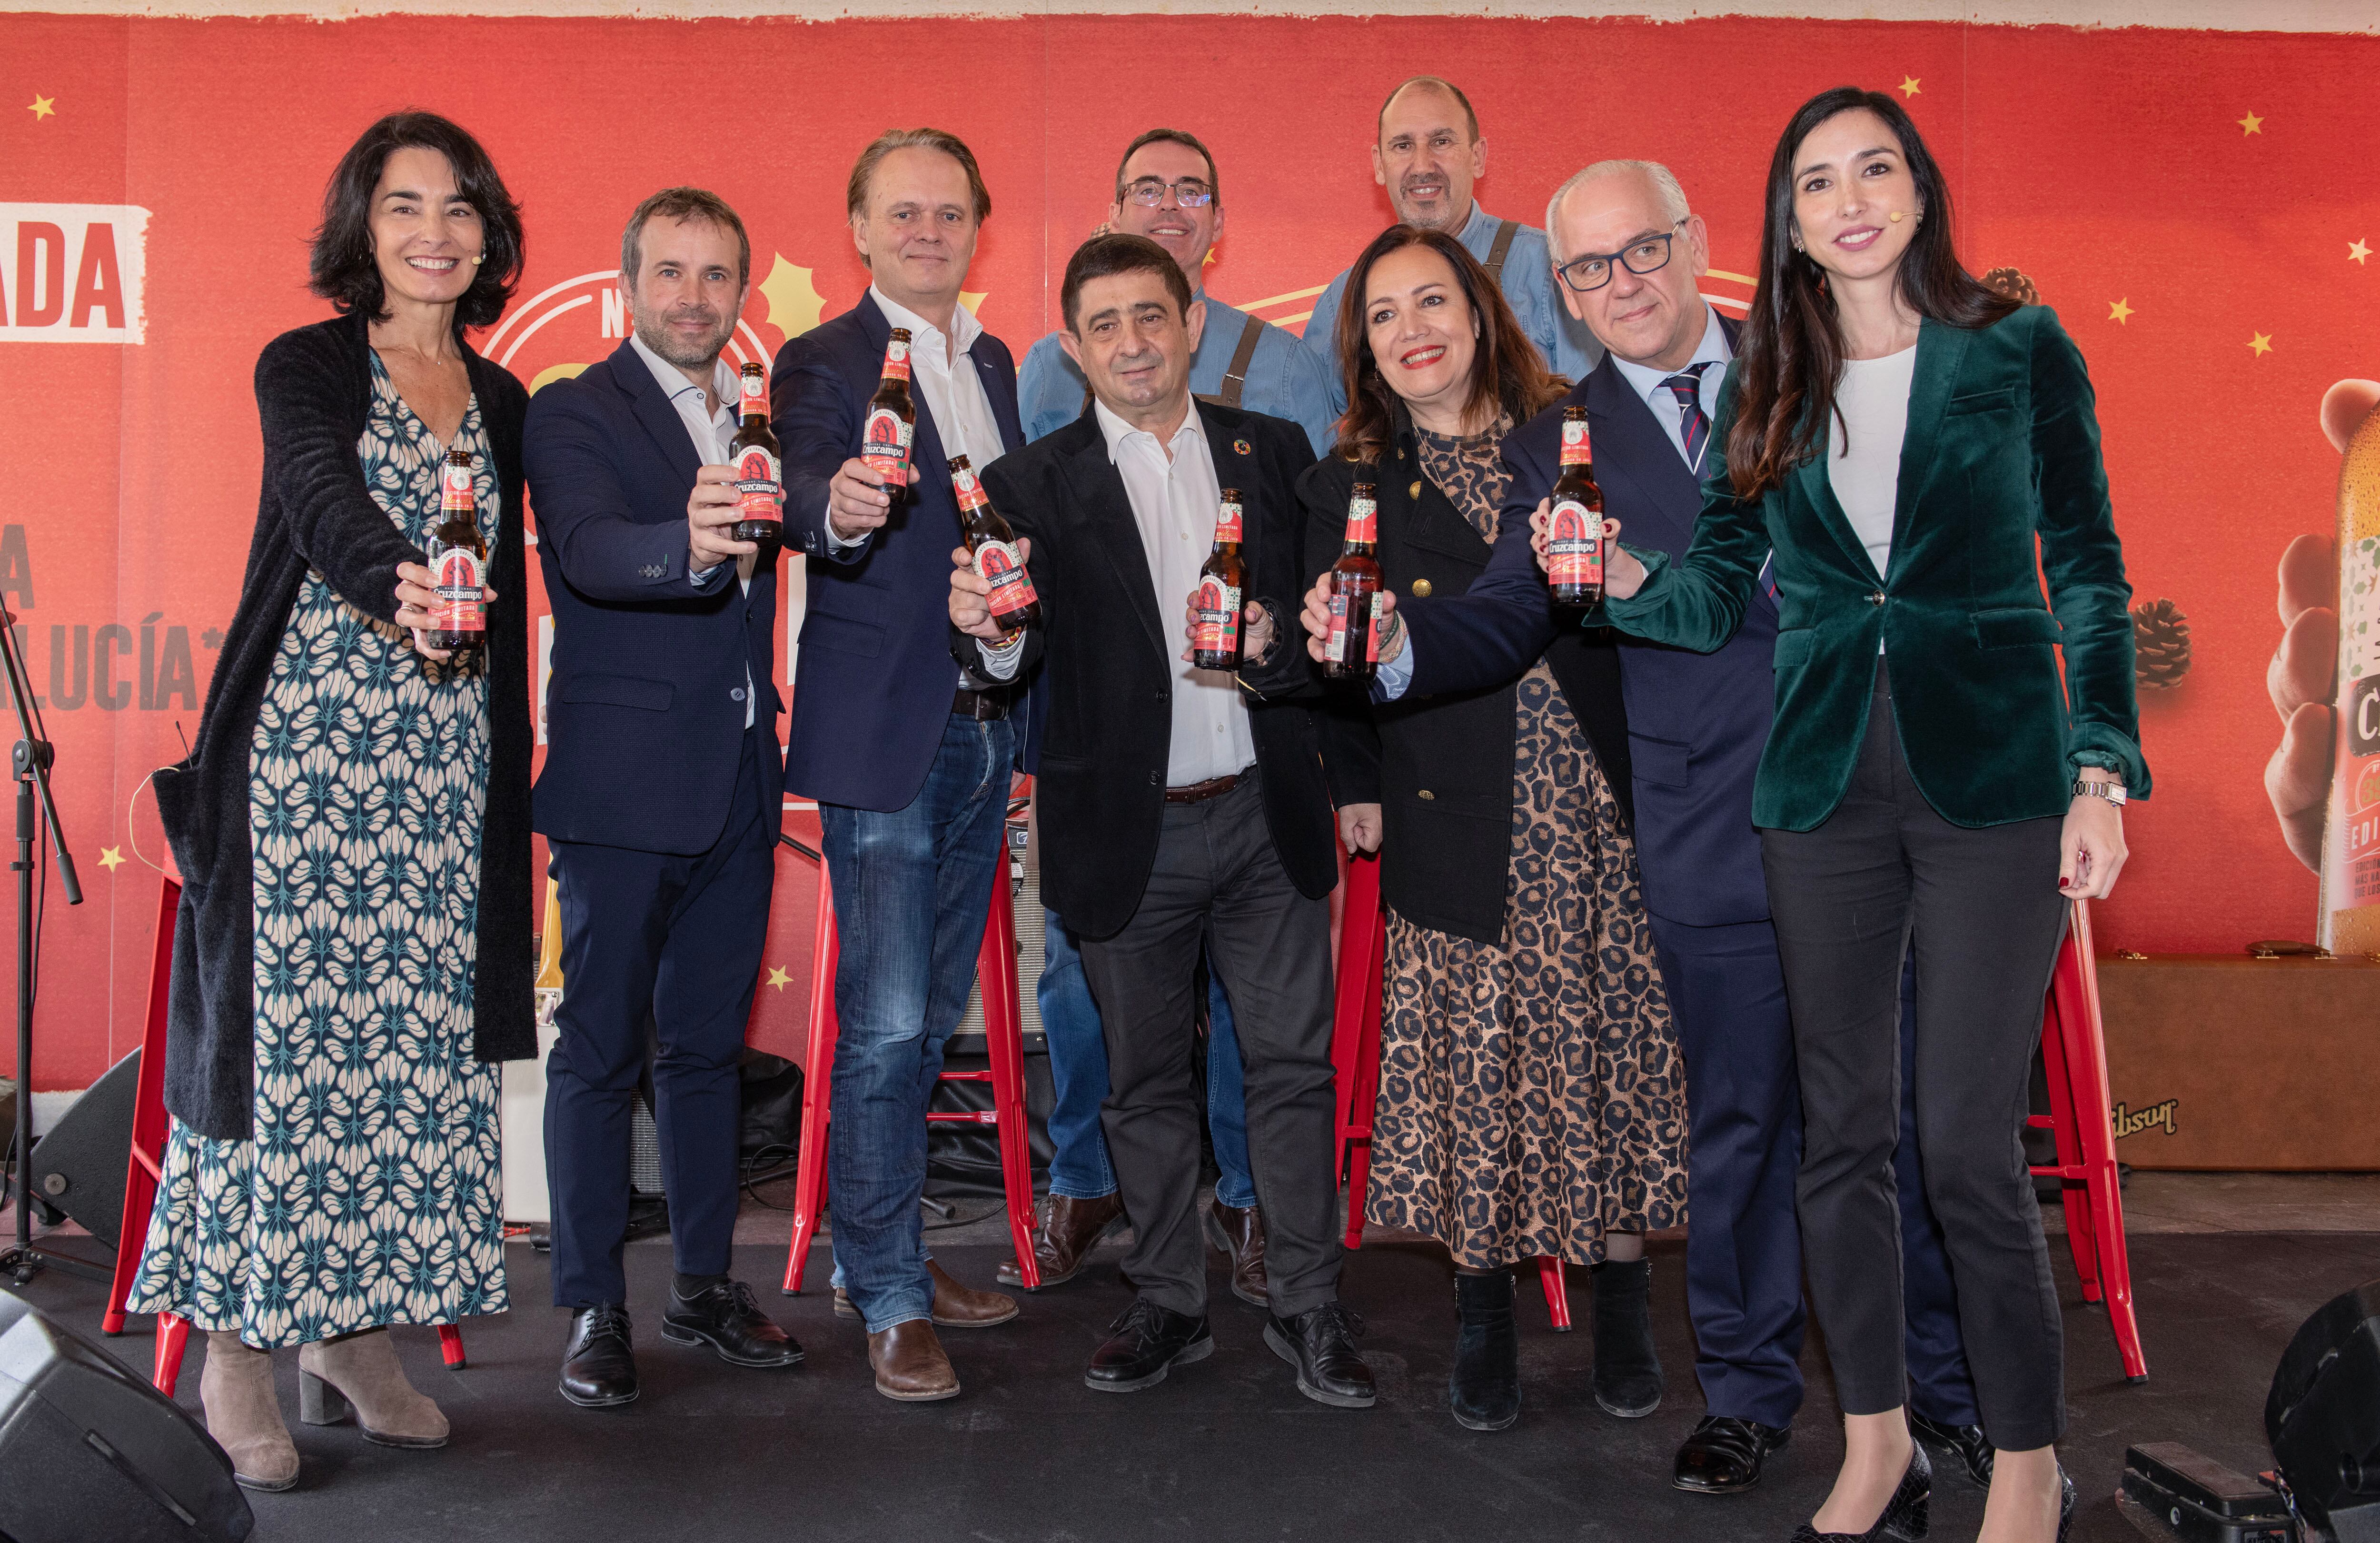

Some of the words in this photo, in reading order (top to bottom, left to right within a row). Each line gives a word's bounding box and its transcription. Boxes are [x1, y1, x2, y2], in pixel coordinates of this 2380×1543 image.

[0, 221, 126, 329] DA
[863, 445, 903, 457] Cruzcampo
[1549, 543, 1595, 553] Cruzcampo
[991, 569, 1023, 587] zcampo
[1002, 584, 1021, 598] LIMITADA
[1200, 613, 1230, 623] zcampo
[0, 612, 225, 710] LUCÍA
[2351, 816, 2379, 850] EDI
[2112, 1100, 2178, 1140] ibson
